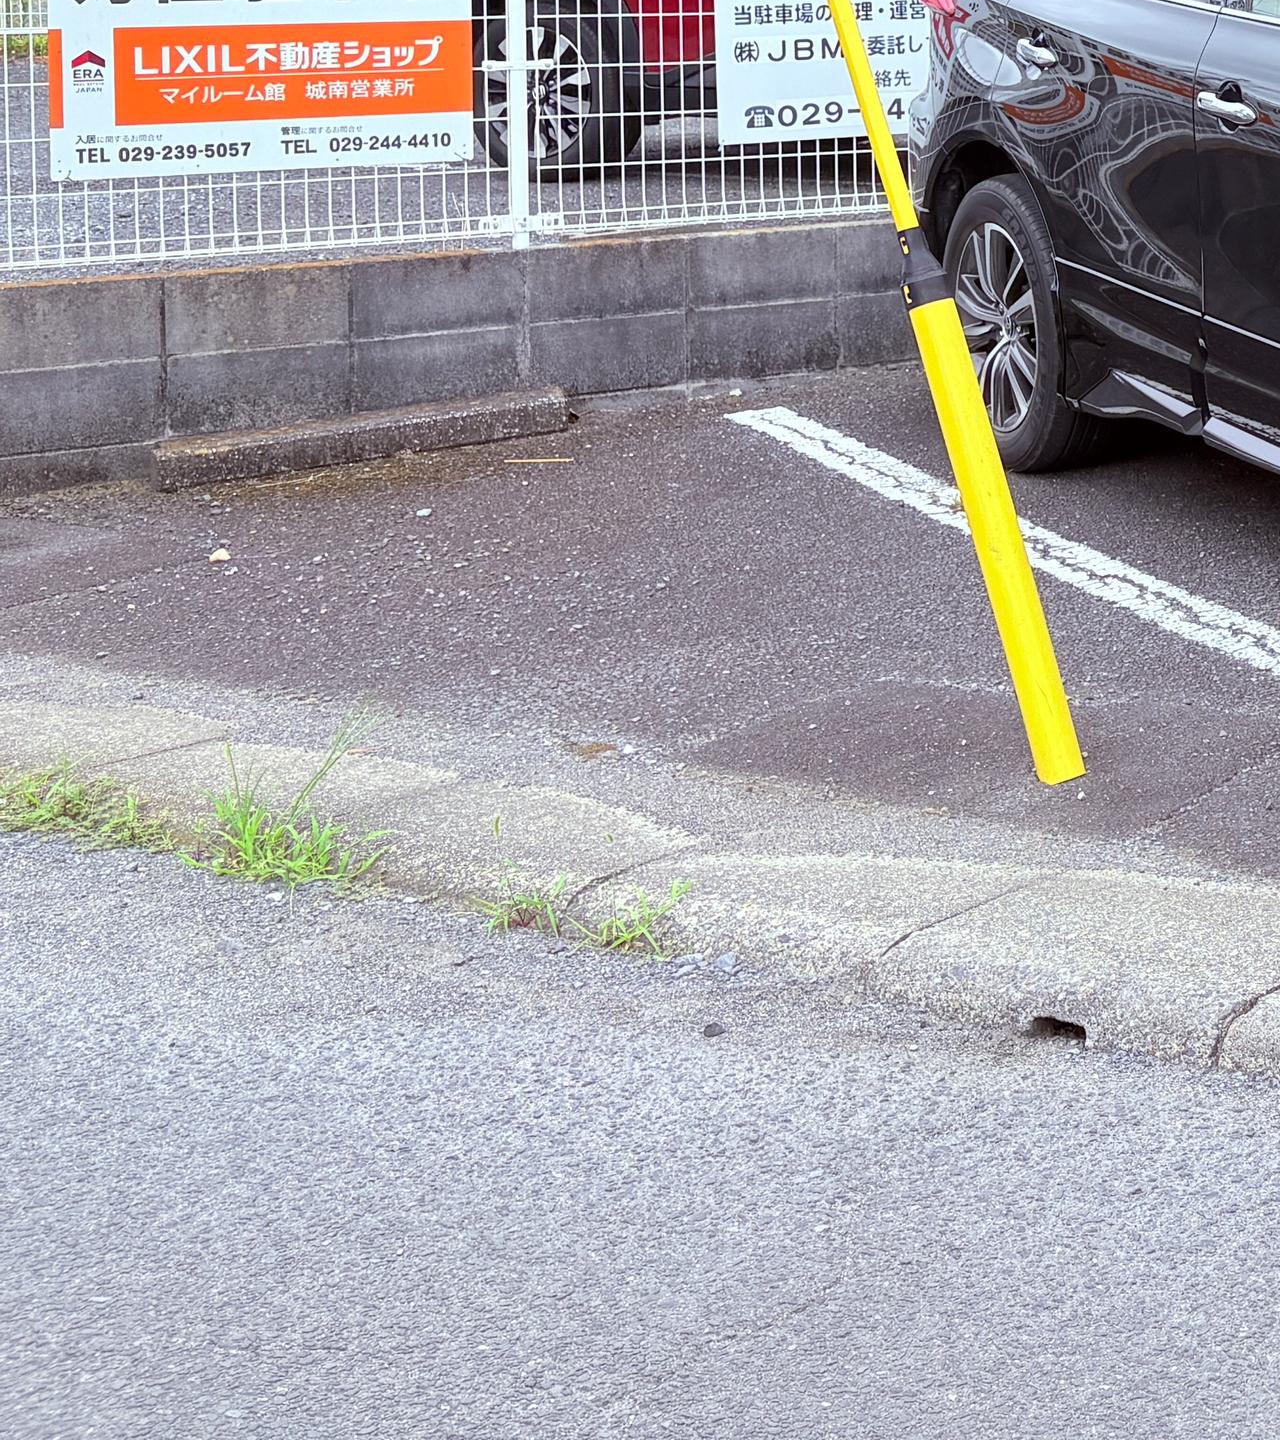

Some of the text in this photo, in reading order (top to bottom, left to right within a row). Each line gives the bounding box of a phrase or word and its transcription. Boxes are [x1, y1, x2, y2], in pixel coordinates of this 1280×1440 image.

[734, 1, 926, 26] 当駐車場の理・運営
[134, 35, 443, 75] LIXIL不動産ショップ
[73, 68, 104, 79] ERA
[874, 68, 912, 88] 絡先
[159, 78, 416, 105] マイルーム館 城南営業所
[777, 97, 911, 127] 029-4
[75, 141, 252, 164] TEL 029-239-5057
[281, 132, 451, 155] TEL 029-244-4410
